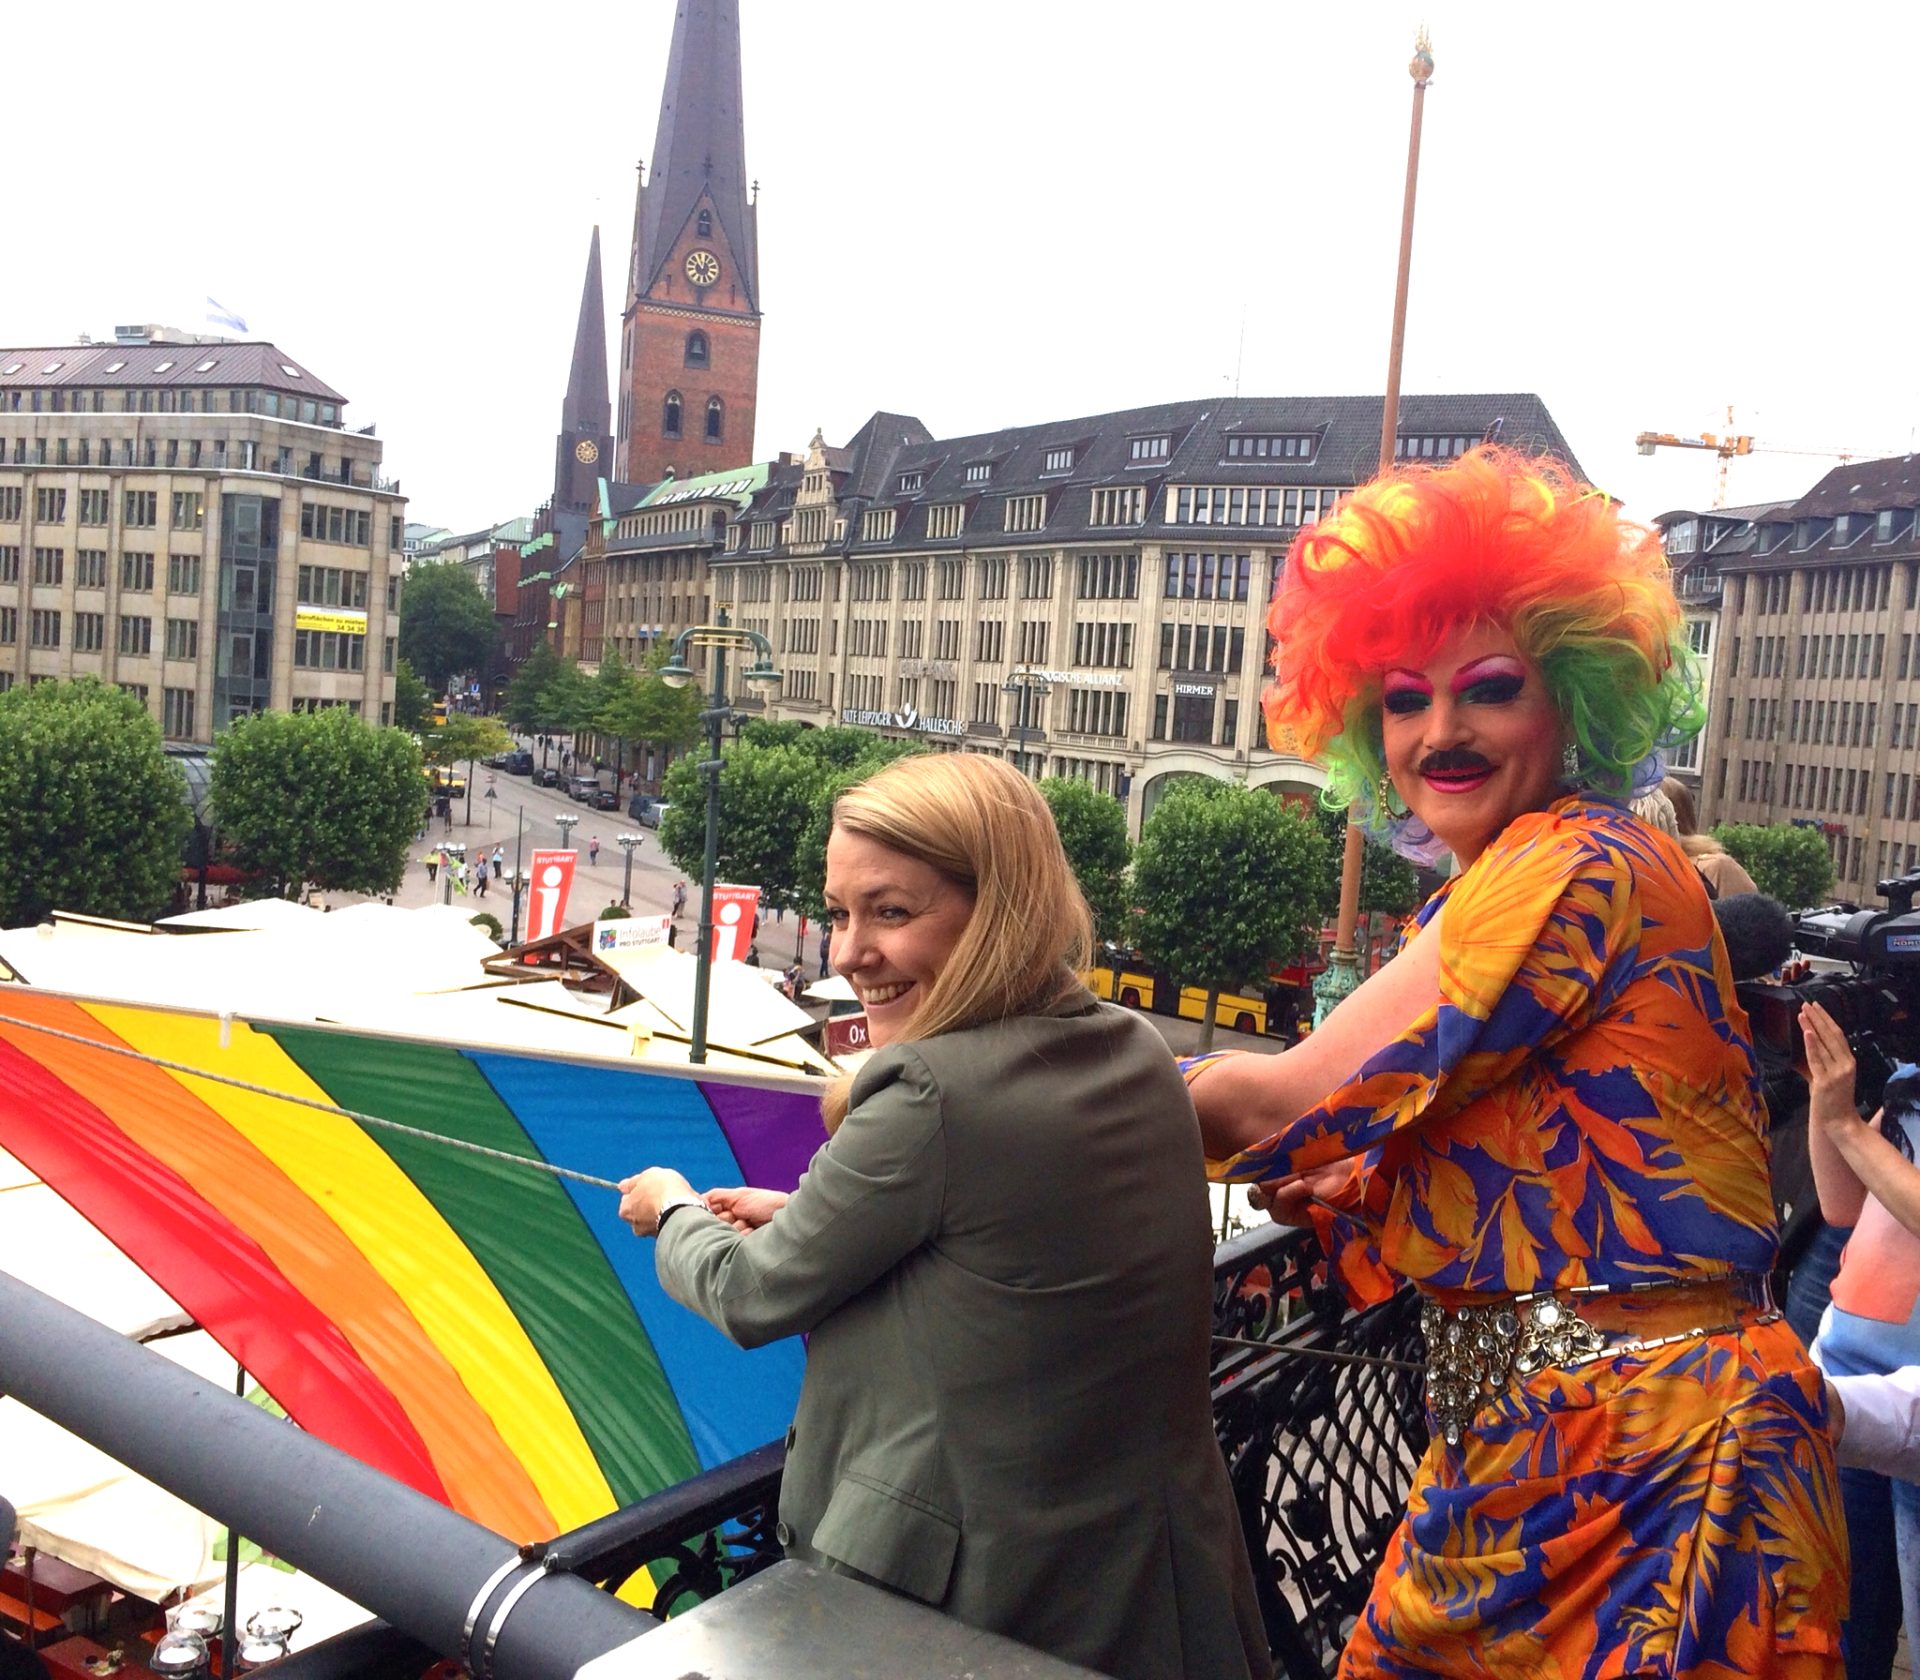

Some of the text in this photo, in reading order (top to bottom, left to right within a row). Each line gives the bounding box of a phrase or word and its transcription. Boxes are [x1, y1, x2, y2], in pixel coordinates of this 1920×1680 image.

[1085, 673, 1123, 686] ALLIANZ
[471, 683, 480, 693] U
[1175, 684, 1214, 696] HIRMER
[843, 709, 892, 726] ALTE LEIPZIGER
[919, 715, 964, 736] HALLESCHE
[537, 855, 574, 865] STUTTGART
[713, 892, 756, 901] STUTTGART
[632, 937, 660, 946] STUTTGART
